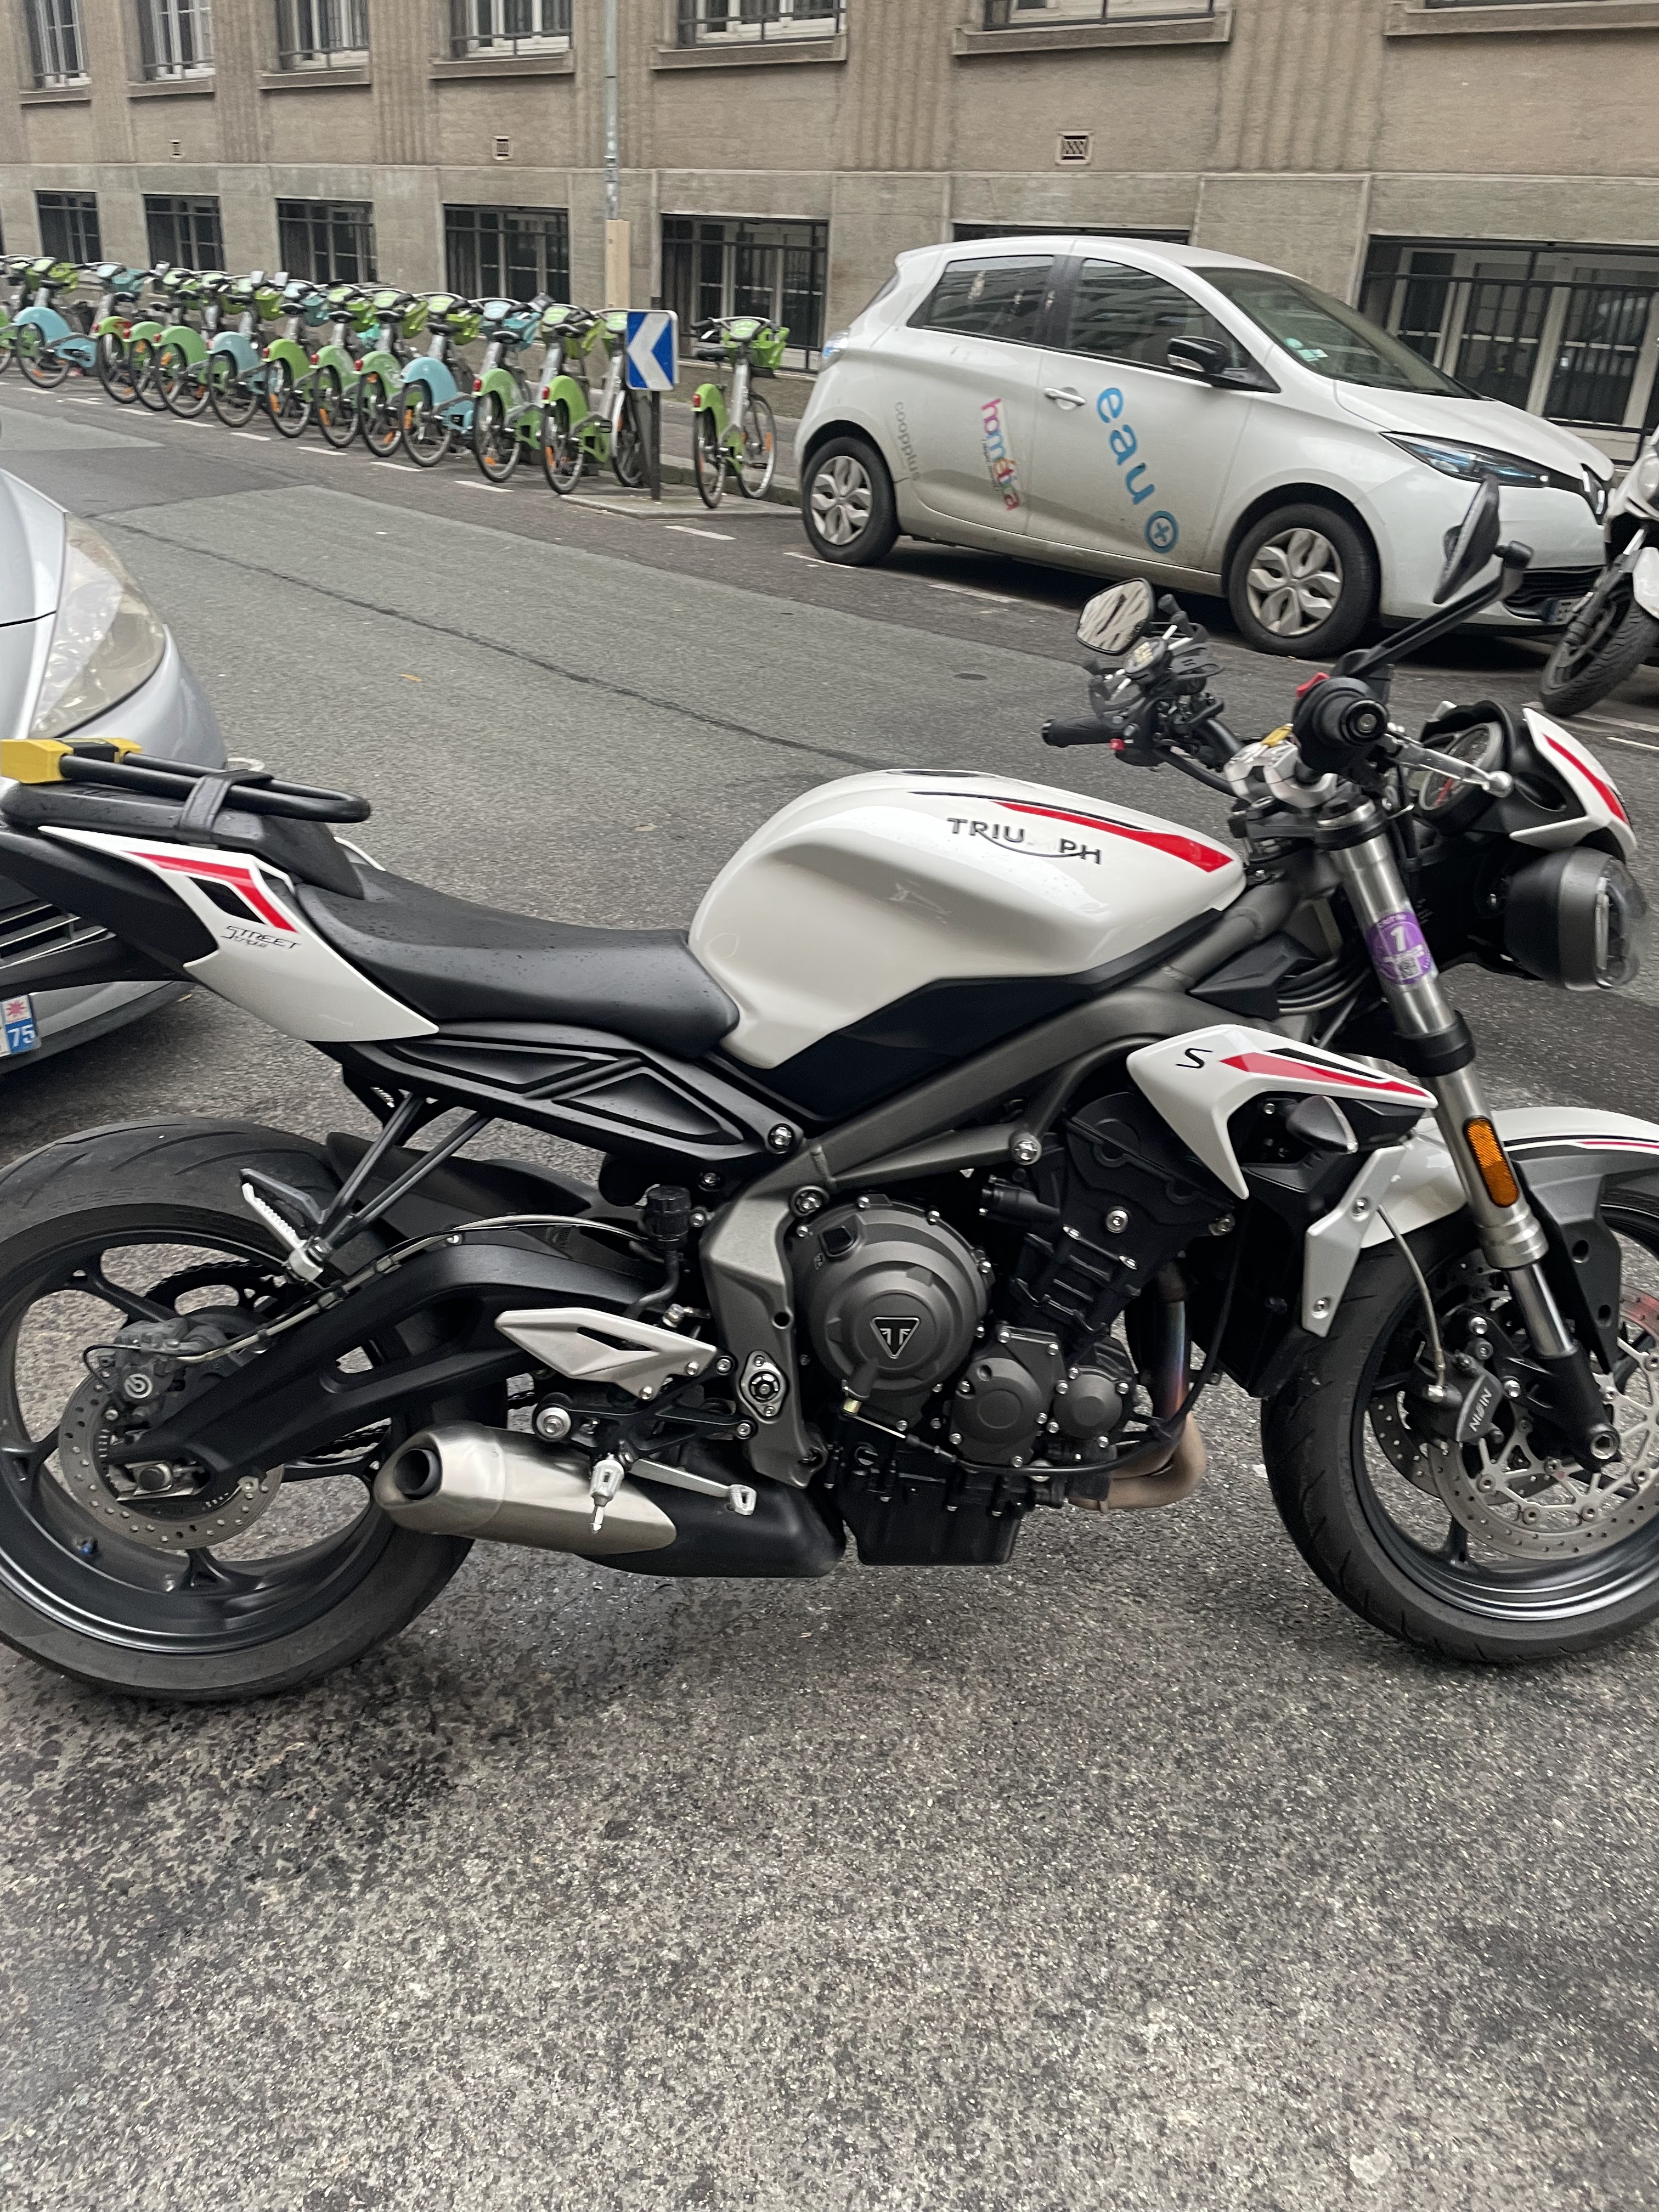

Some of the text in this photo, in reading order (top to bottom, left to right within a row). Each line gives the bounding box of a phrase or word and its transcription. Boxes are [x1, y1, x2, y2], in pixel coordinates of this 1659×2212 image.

[1097, 387, 1155, 505] eau
[947, 818, 1102, 865] TRIUPH
[7, 1024, 36, 1048] 75
[1175, 1048, 1213, 1069] S
